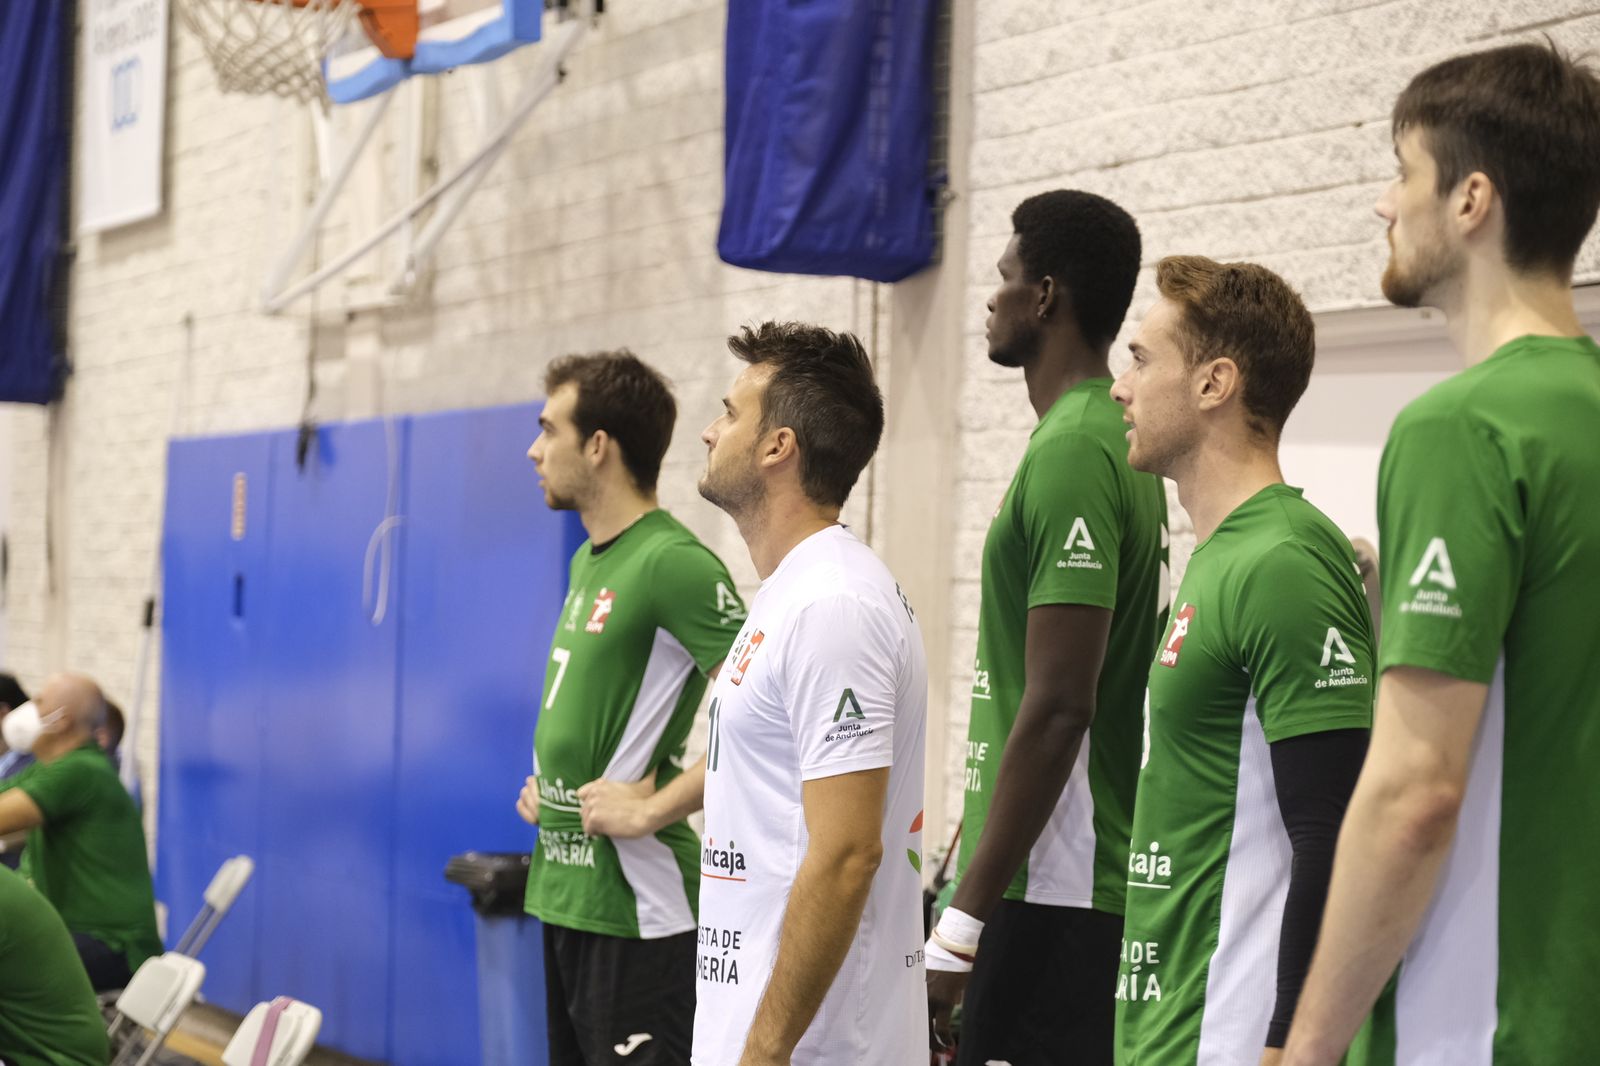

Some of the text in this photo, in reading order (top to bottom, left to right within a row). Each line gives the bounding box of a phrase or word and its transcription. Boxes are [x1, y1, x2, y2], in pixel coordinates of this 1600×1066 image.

[1069, 552, 1091, 560] Junta
[1056, 560, 1067, 568] de
[545, 647, 571, 710] 7
[1329, 668, 1355, 677] Junta
[1314, 674, 1368, 689] de Andalucía
[838, 723, 861, 732] Junta
[825, 734, 835, 742] de
[722, 929, 742, 950] DE
[1130, 940, 1160, 965] DE
[696, 950, 739, 985] MERÍA
[1115, 964, 1162, 1002] RÍA
